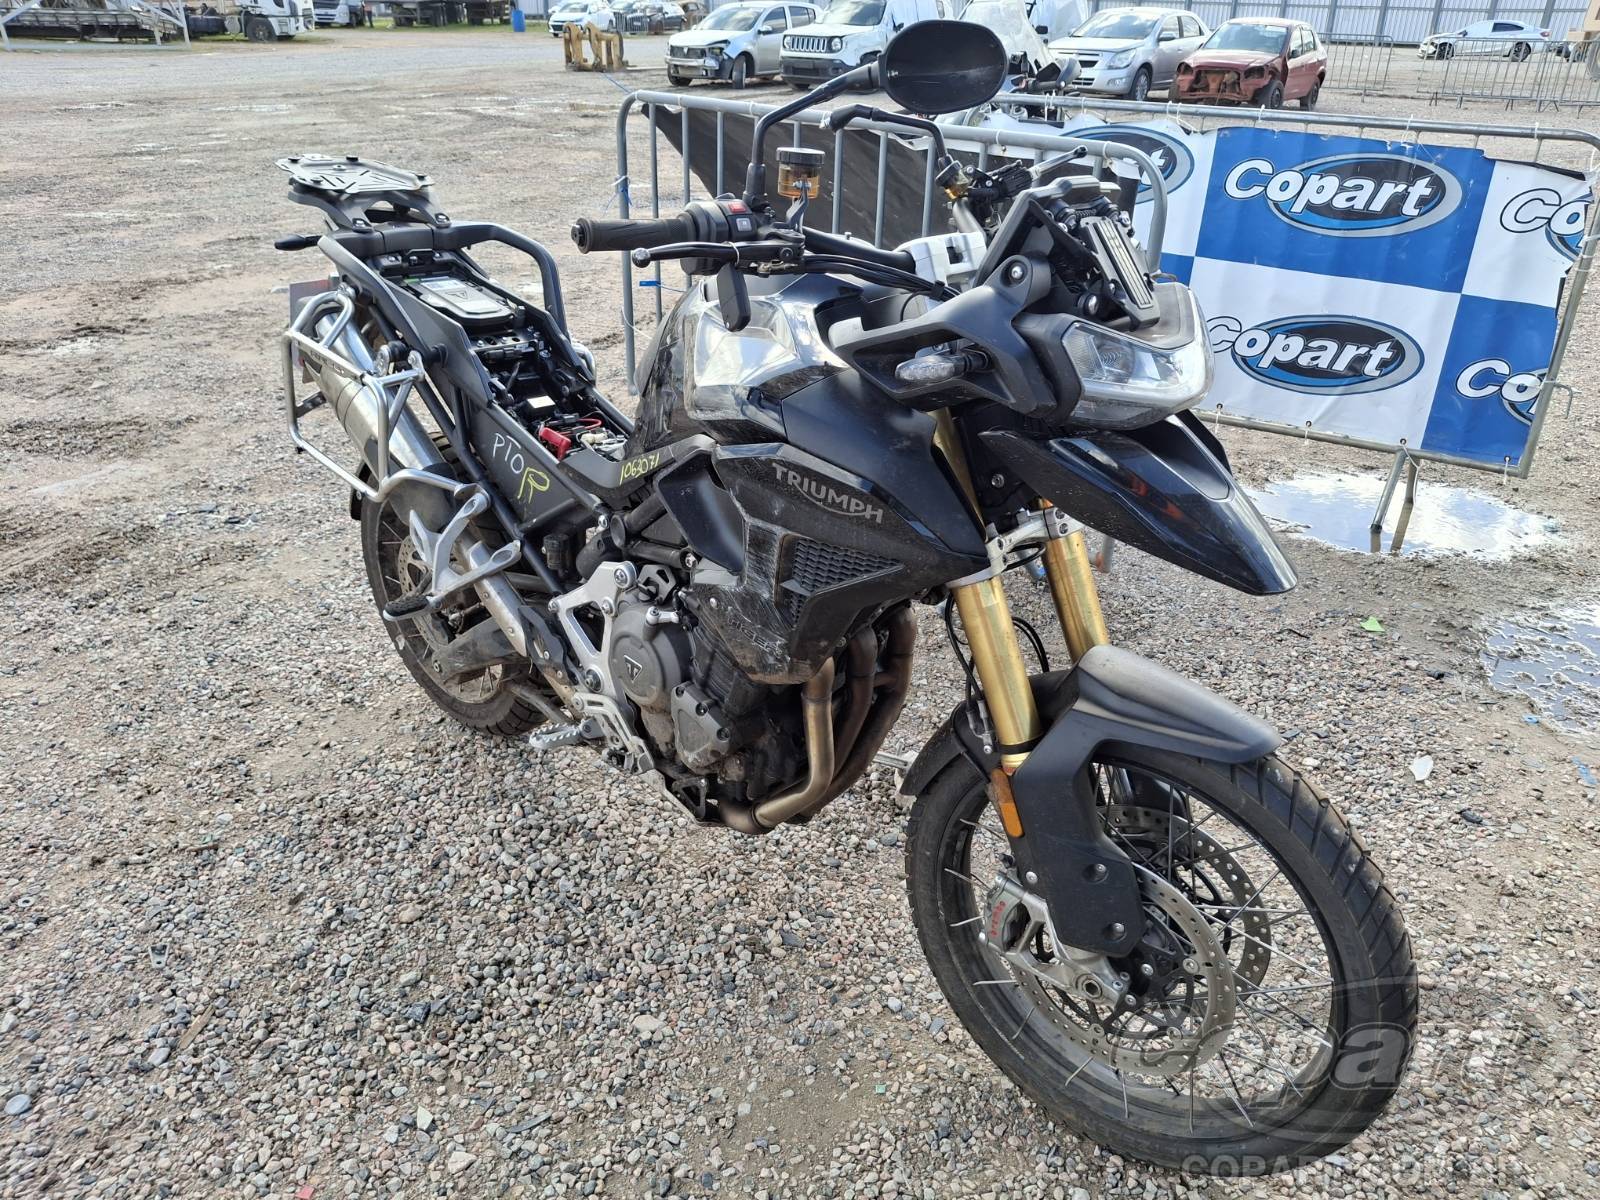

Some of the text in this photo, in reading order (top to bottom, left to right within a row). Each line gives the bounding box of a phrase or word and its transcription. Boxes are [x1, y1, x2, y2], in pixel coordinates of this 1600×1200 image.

[1224, 158, 1434, 218] Copart
[1500, 188, 1588, 247] Co
[1206, 316, 1394, 377] Copart
[1456, 359, 1541, 412] Co
[492, 432, 525, 474] PTO
[772, 462, 884, 524] TRIUMPH
